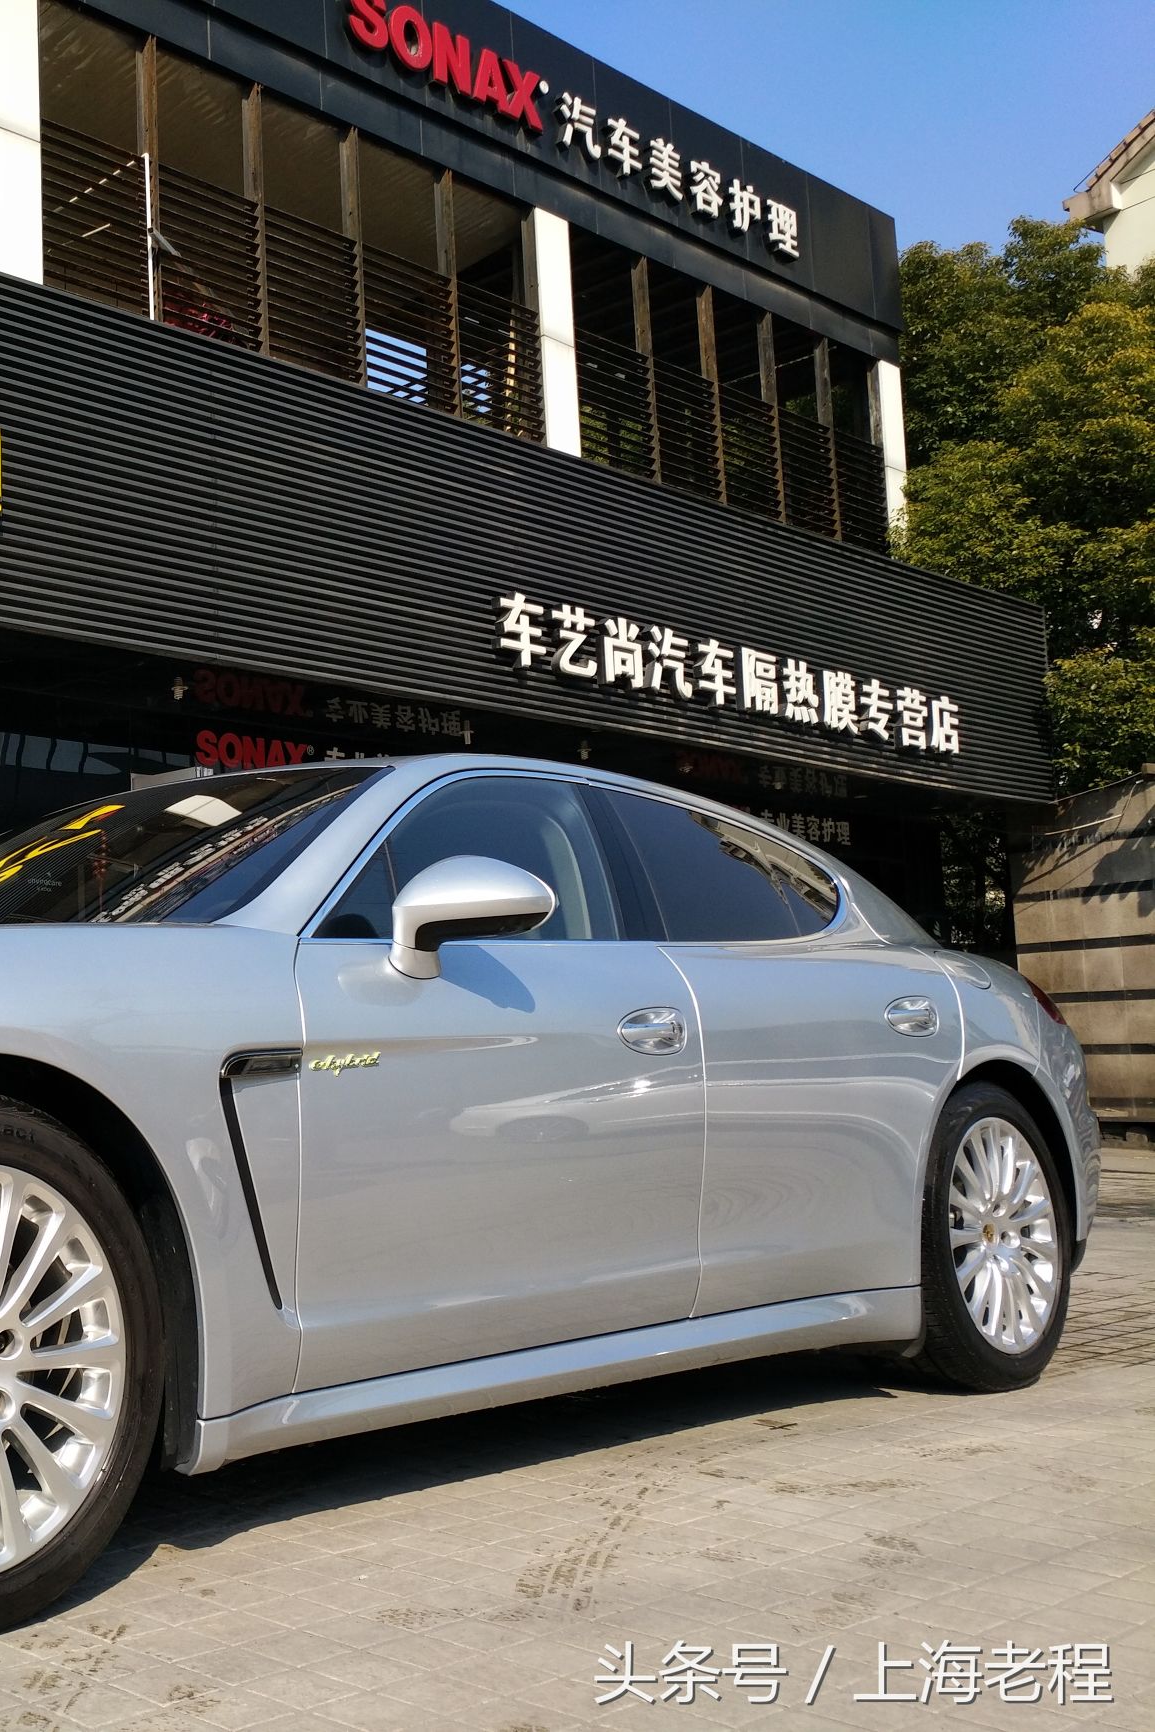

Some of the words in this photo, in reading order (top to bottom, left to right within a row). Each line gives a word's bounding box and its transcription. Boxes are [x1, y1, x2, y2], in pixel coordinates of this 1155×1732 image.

[559, 91, 800, 260] 汽车美容护理
[496, 592, 961, 756] 车艺尚汽车隔热膜专营店
